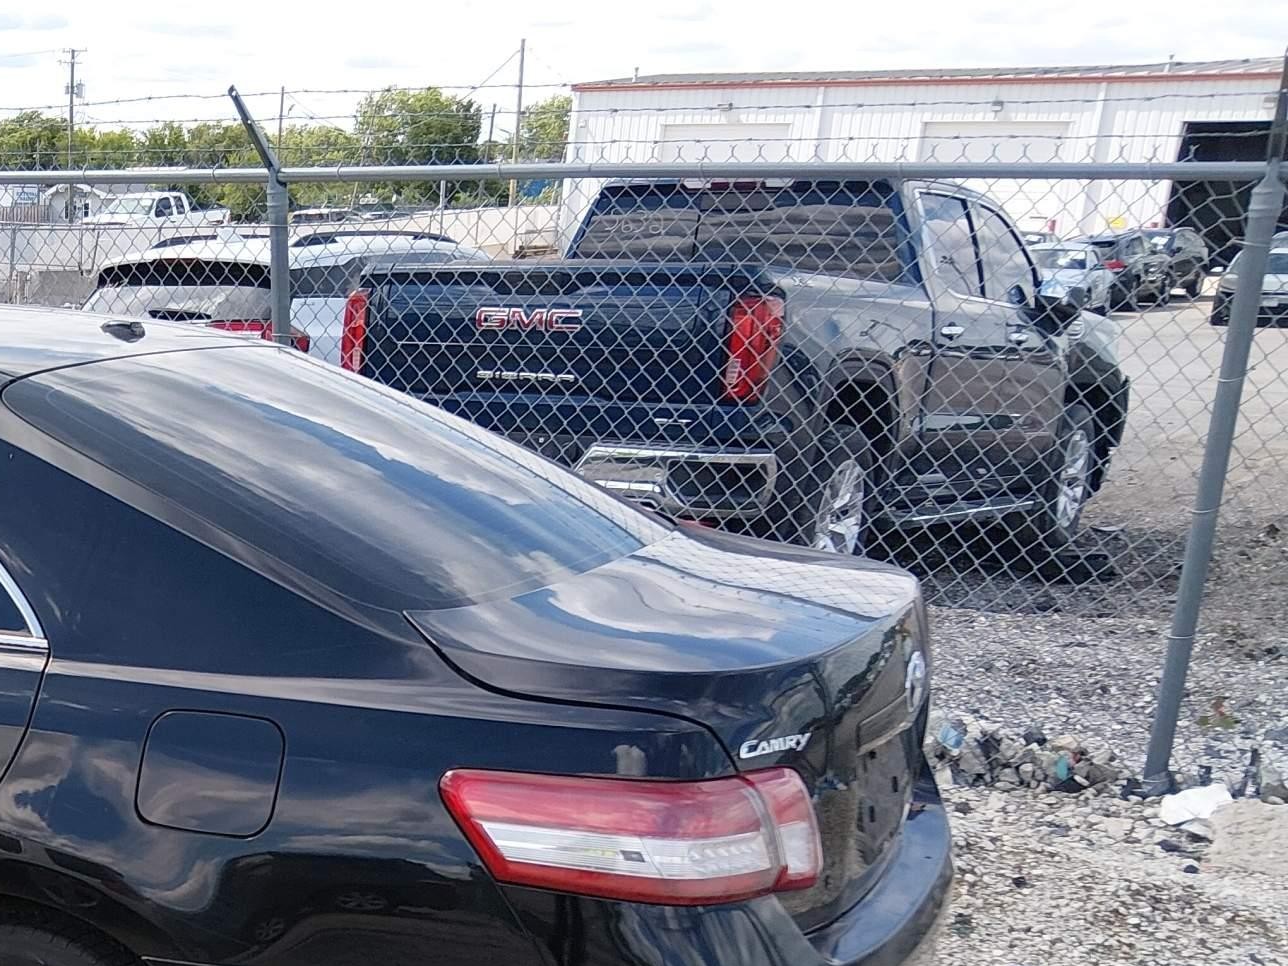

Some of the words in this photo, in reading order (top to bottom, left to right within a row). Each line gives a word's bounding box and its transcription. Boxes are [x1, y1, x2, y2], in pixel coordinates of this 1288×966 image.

[475, 306, 583, 332] GMC
[476, 370, 575, 383] SIERRA
[739, 732, 812, 760] CAMRY
